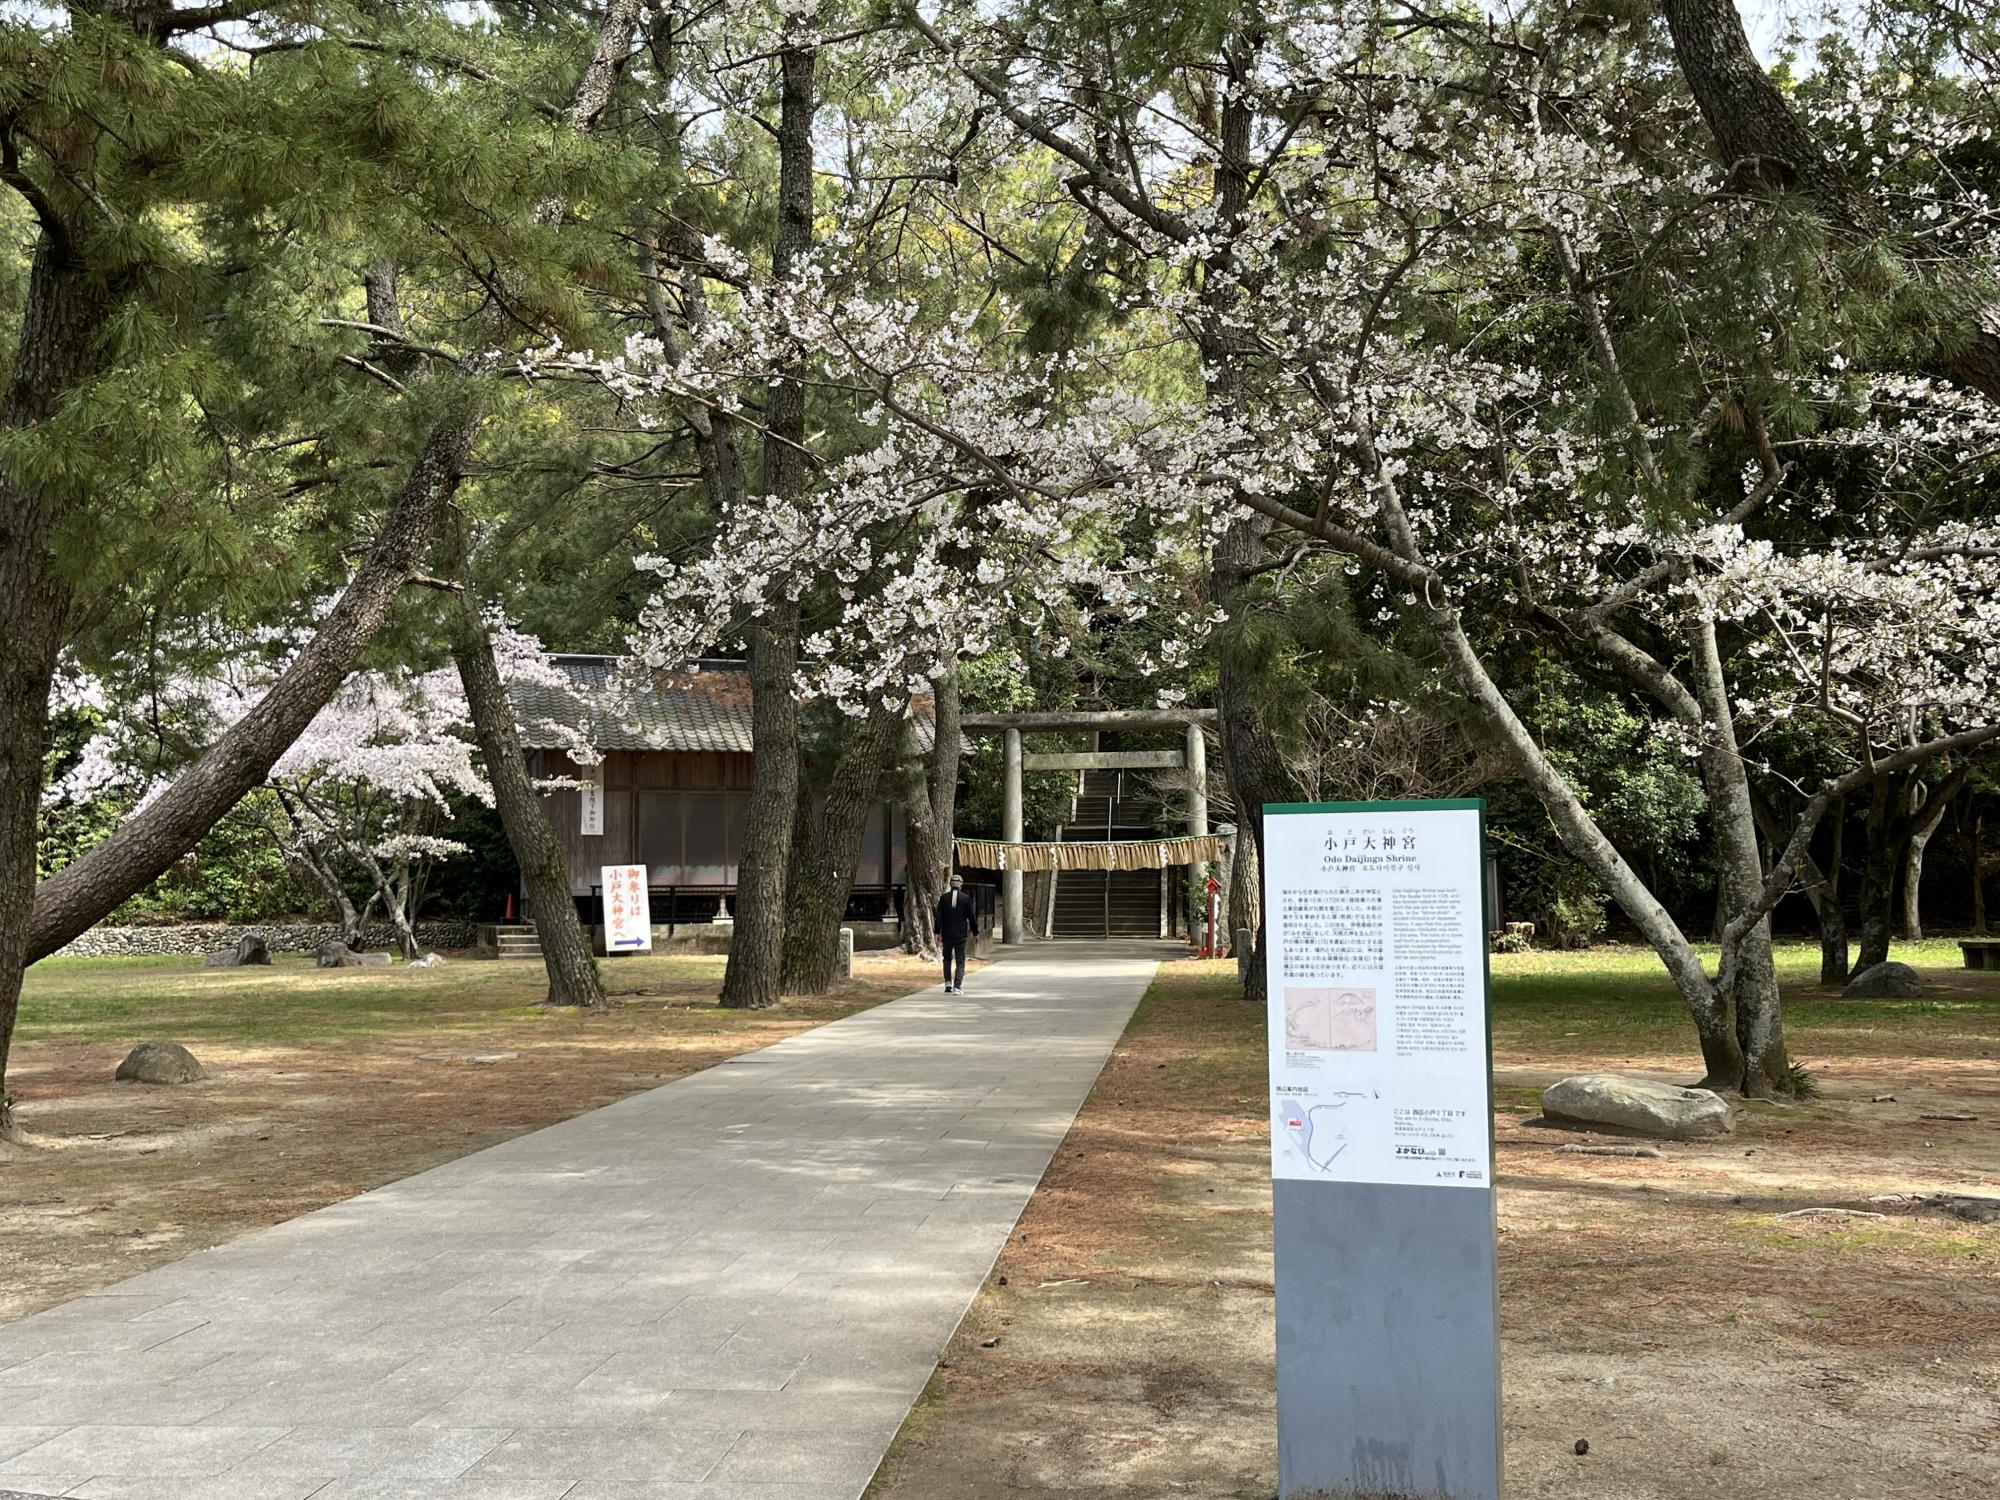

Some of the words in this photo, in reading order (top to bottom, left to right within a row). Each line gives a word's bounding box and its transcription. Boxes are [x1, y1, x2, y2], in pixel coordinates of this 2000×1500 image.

[1324, 836, 1416, 850] 小戸大神宮
[1345, 855, 1383, 864] Daijingu
[610, 869, 626, 938] 小戸大神宮へ
[627, 868, 641, 916] 御参りは
